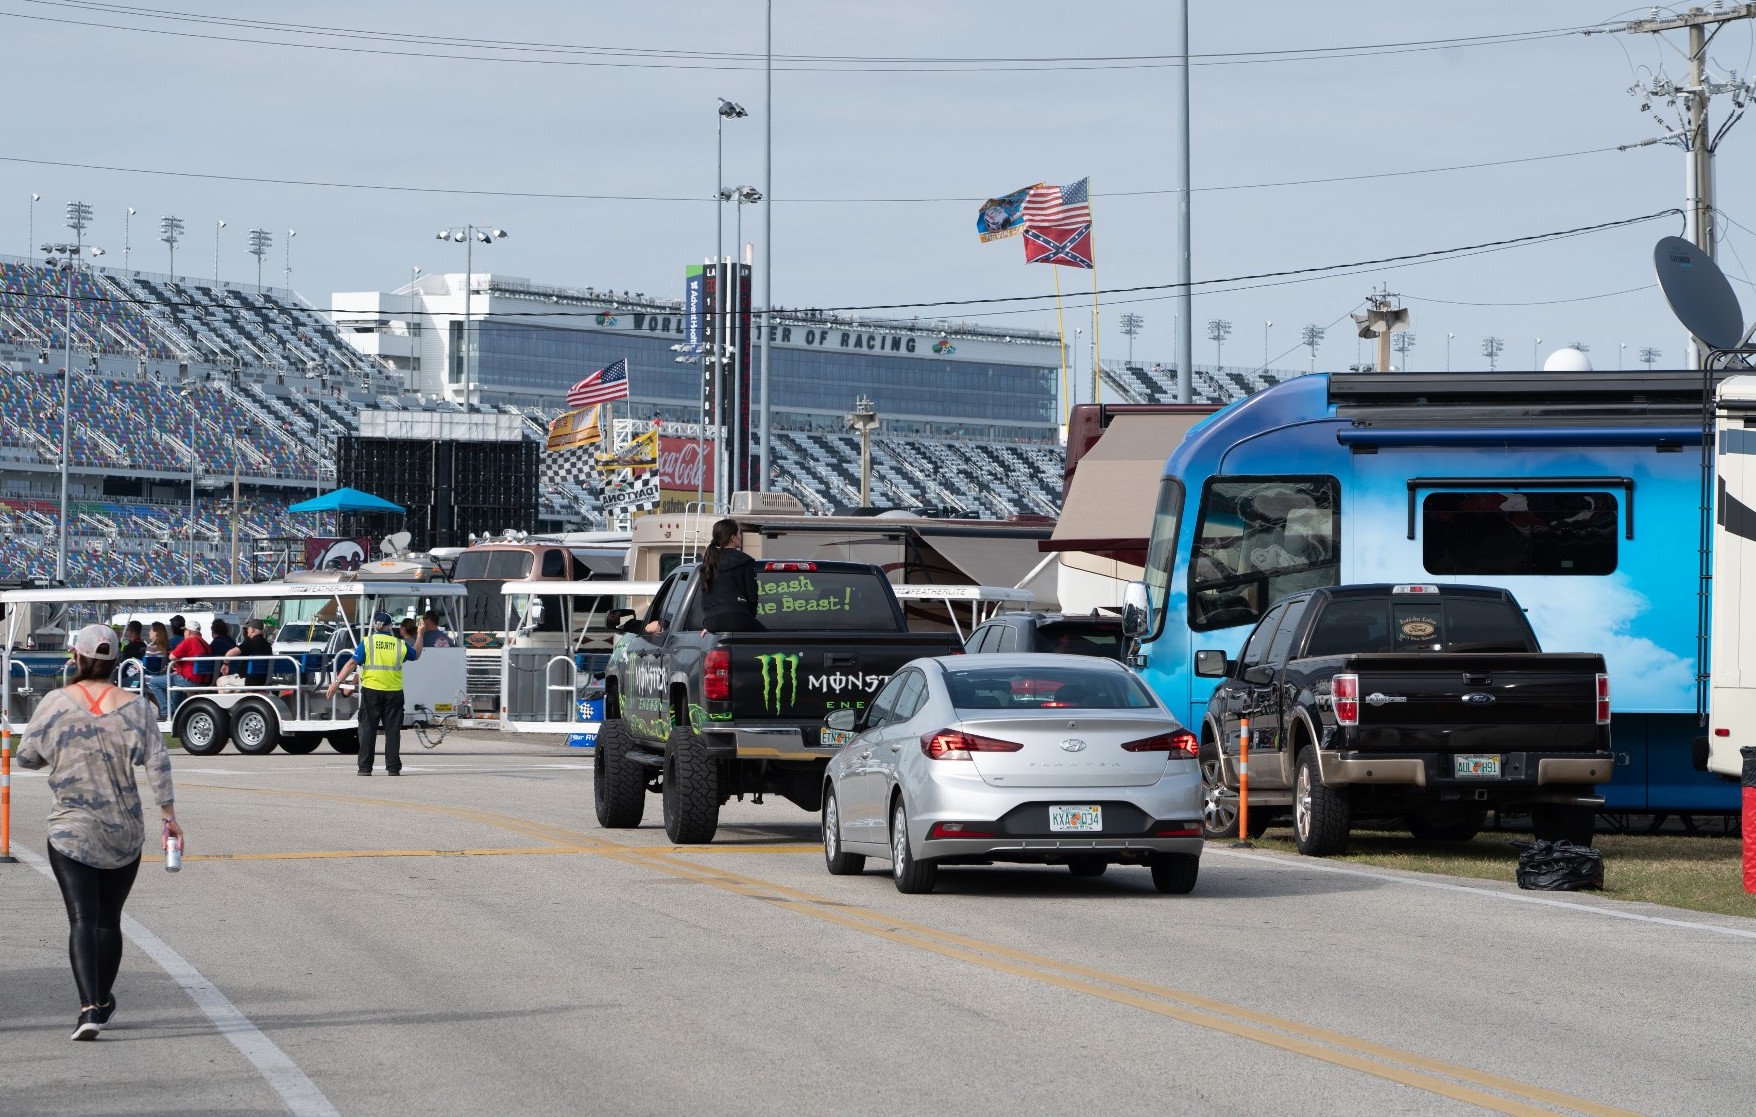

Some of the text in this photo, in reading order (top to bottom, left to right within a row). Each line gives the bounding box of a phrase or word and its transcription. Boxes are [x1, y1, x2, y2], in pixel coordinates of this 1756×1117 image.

[706, 268, 716, 277] LA
[633, 313, 684, 334] WORL
[805, 329, 829, 346] OF
[840, 332, 917, 353] RACING
[756, 575, 814, 596] leash
[375, 640, 396, 651] SECURITY
[808, 671, 892, 694] MONST
[826, 701, 865, 709] ENE
[1458, 761, 1497, 773] AUL H91
[1052, 812, 1070, 826] KXA
